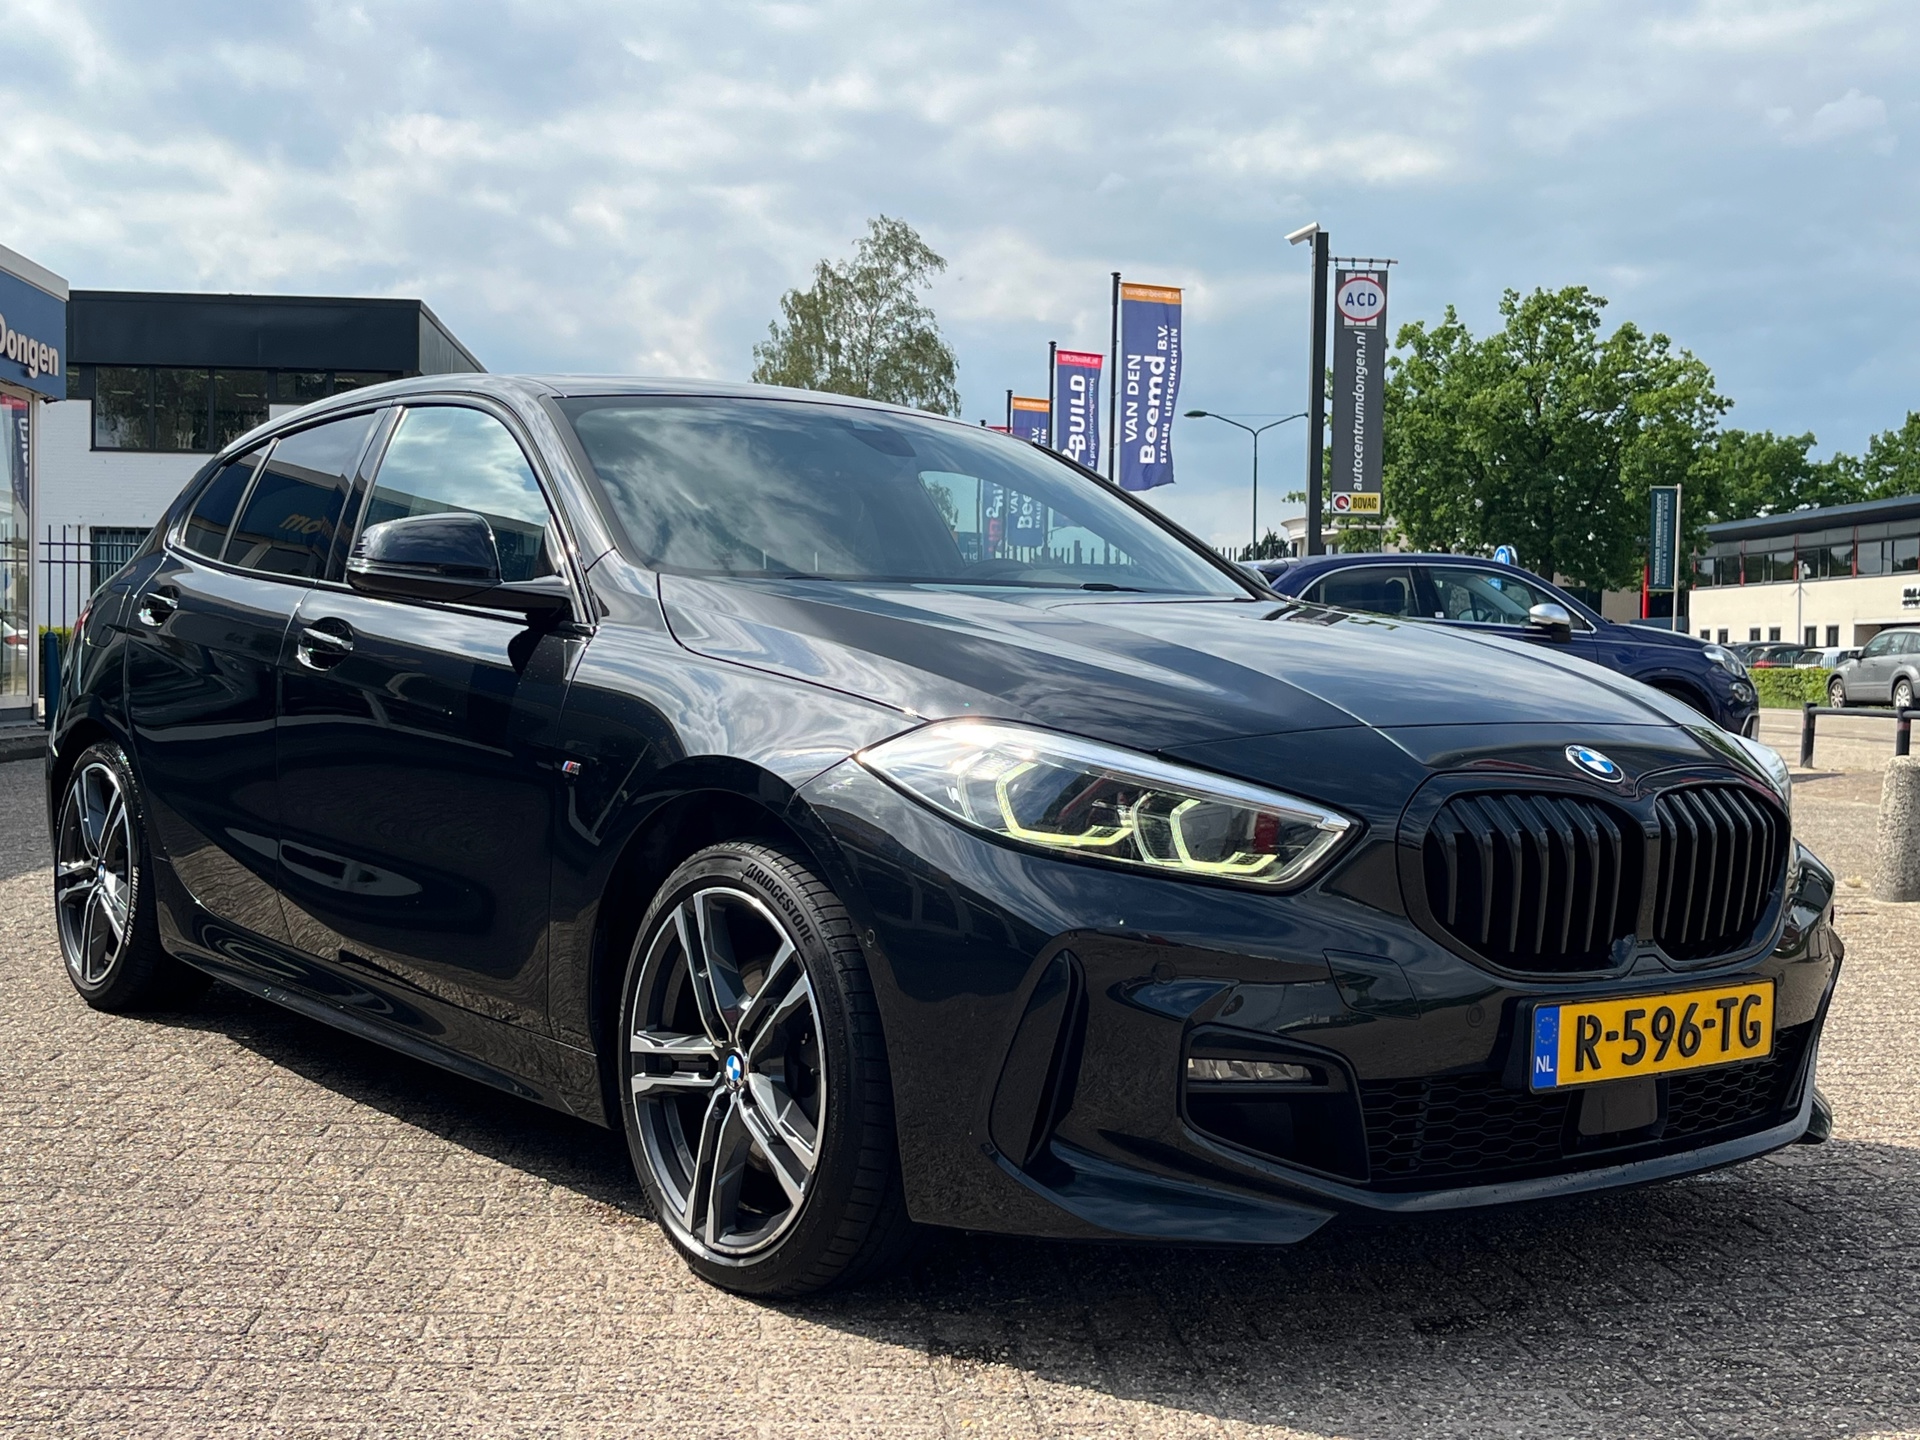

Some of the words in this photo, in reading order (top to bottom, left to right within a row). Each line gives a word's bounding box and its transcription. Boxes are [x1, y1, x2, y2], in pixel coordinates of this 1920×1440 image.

[1345, 292, 1377, 306] ACD
[1127, 354, 1141, 395] DEN
[1140, 355, 1165, 464] Beemd
[1157, 325, 1168, 350] B.V.
[1164, 328, 1178, 417] LIFTSCHACHTEN
[1088, 377, 1097, 459] projectmanagement
[1125, 402, 1139, 442] VAN
[1352, 330, 1368, 491] autocentrumdongen.nl
[1160, 423, 1170, 464] STALEN
[1352, 497, 1377, 509] BOVAG
[743, 863, 815, 947] BRIDGESTONE
[1574, 994, 1762, 1073] R-596-TG
[1535, 1055, 1554, 1073] NL
